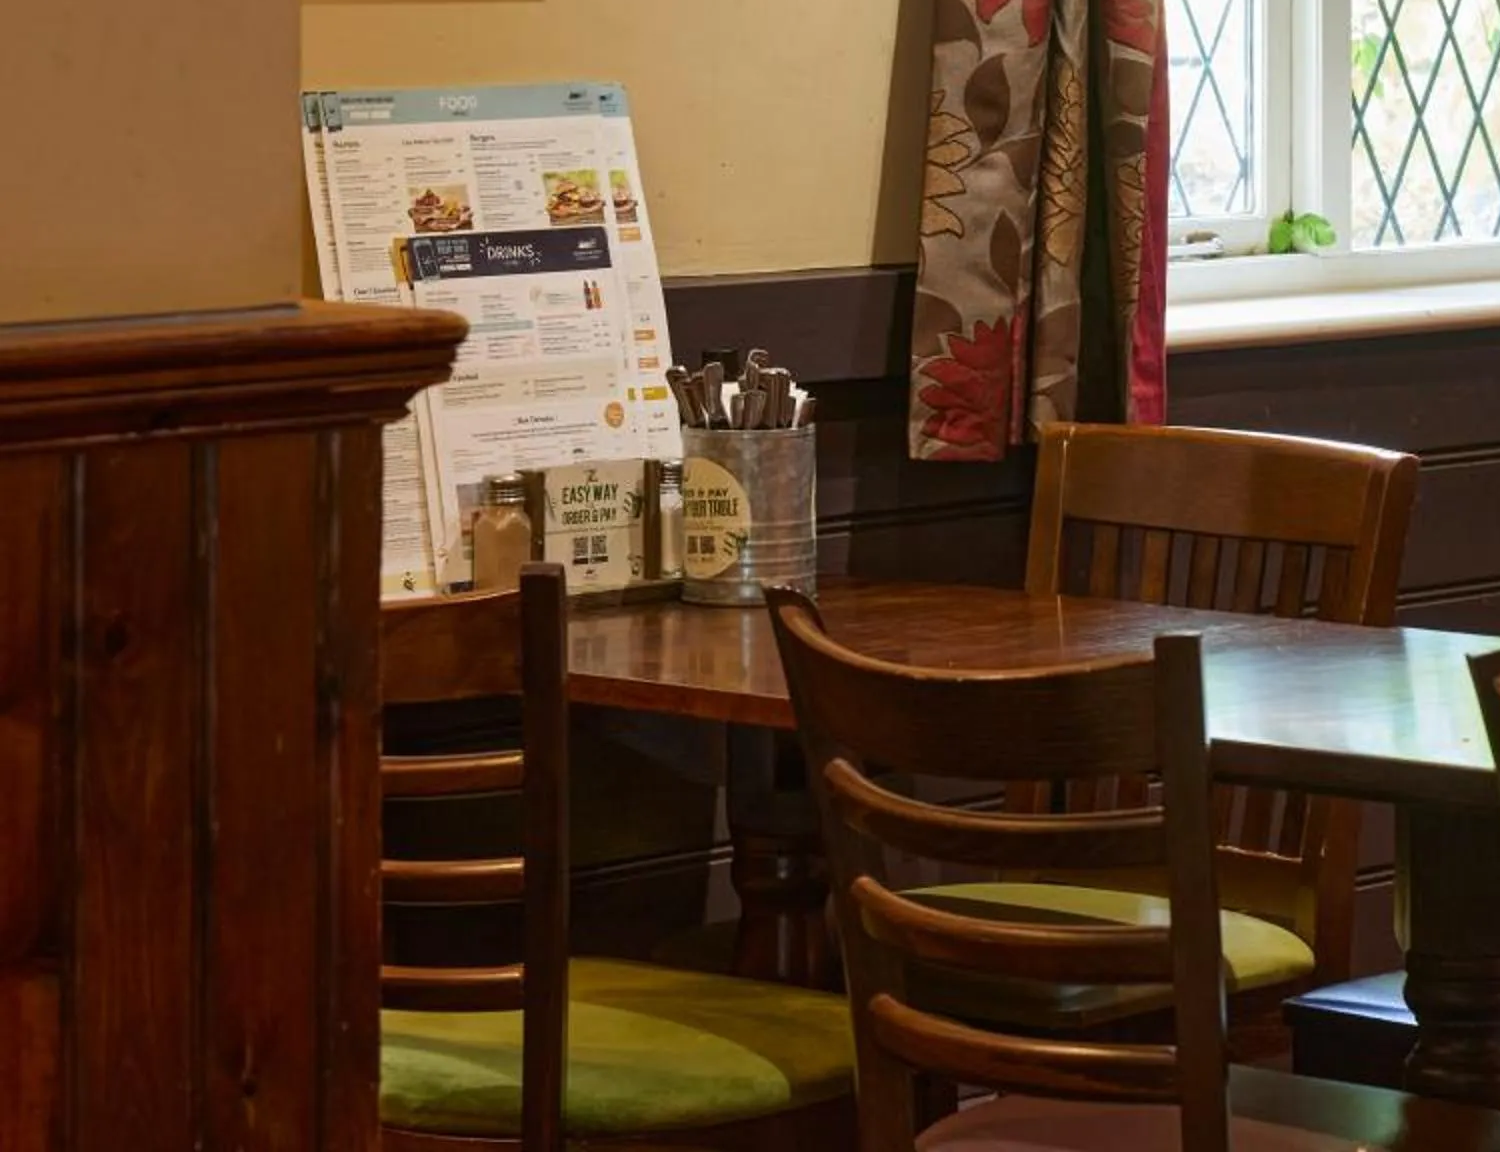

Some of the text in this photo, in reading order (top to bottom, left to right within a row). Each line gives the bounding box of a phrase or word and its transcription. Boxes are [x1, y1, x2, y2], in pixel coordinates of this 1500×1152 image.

[438, 95, 478, 111] FOOD
[486, 243, 536, 261] DRINKS
[562, 483, 618, 504] EASY WAY
[708, 488, 729, 497] PAY
[562, 509, 590, 525] ORDER
[600, 507, 617, 521] PAY
[708, 498, 738, 517] TABLE
